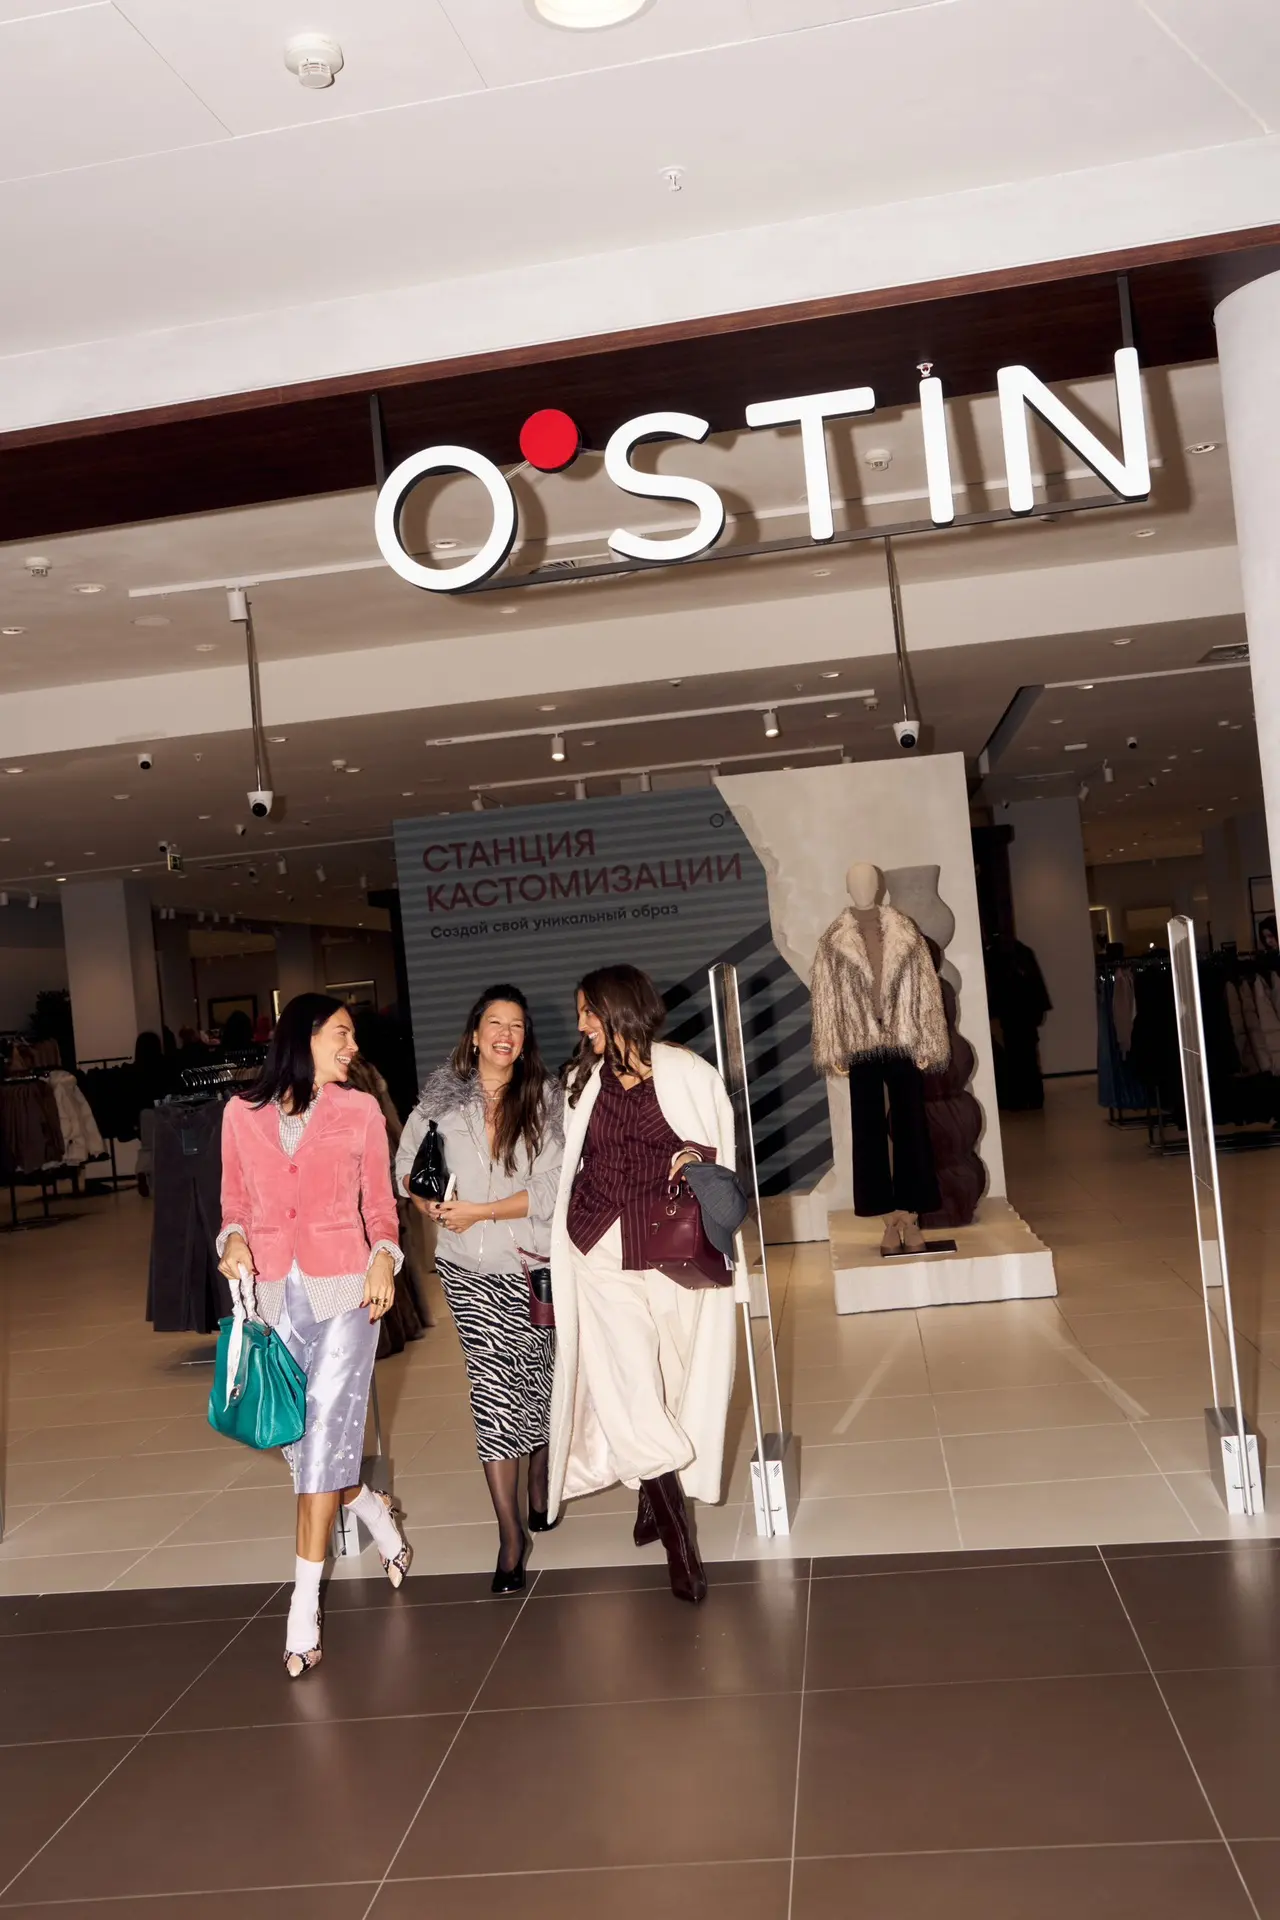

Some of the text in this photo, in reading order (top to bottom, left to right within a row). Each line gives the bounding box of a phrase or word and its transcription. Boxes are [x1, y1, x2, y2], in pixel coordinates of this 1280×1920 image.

[423, 828, 595, 873] СТАНЦИЯ
[426, 852, 742, 913] КАСТОМИЗАЦИИ
[430, 904, 679, 939] Создай свой уникальный образ
